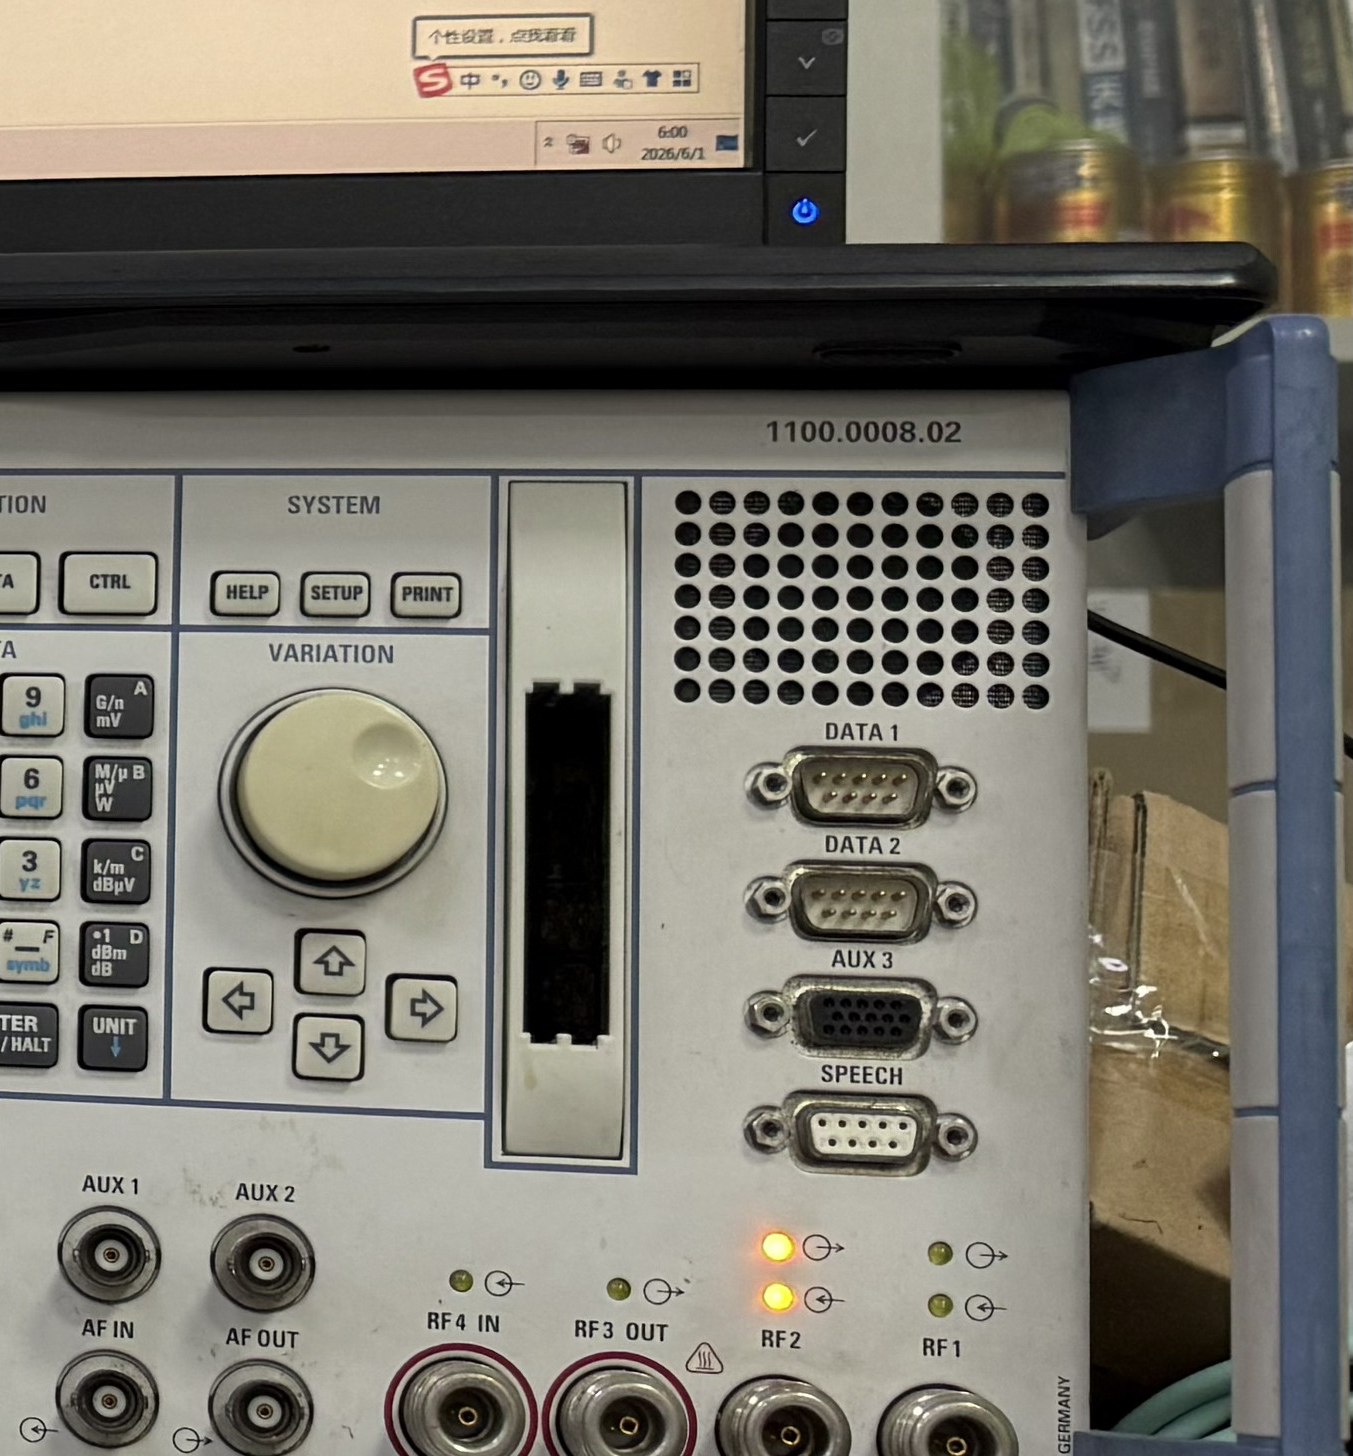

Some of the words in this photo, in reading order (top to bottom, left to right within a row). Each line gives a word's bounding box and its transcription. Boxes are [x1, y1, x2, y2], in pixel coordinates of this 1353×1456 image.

[657, 124, 690, 139] 6:00
[766, 420, 962, 443] 1100.0008.02
[287, 494, 381, 515] SYSTEM
[89, 573, 132, 590] CTRL
[226, 584, 270, 601] HELP
[310, 584, 364, 602] SETUP
[401, 585, 454, 603] PRINT
[268, 643, 394, 664] VARIATION
[825, 722, 884, 742] DATA
[891, 724, 898, 742] 1
[825, 834, 884, 855] DATA
[889, 837, 901, 855] 2
[92, 1016, 138, 1036] UNIT
[821, 1064, 903, 1086] SPEECH
[81, 1318, 107, 1337] AF
[113, 1320, 134, 1339] IN
[225, 1327, 252, 1346] AF
[257, 1328, 300, 1349] OUT
[1057, 1375, 1072, 1455] GERMANY
